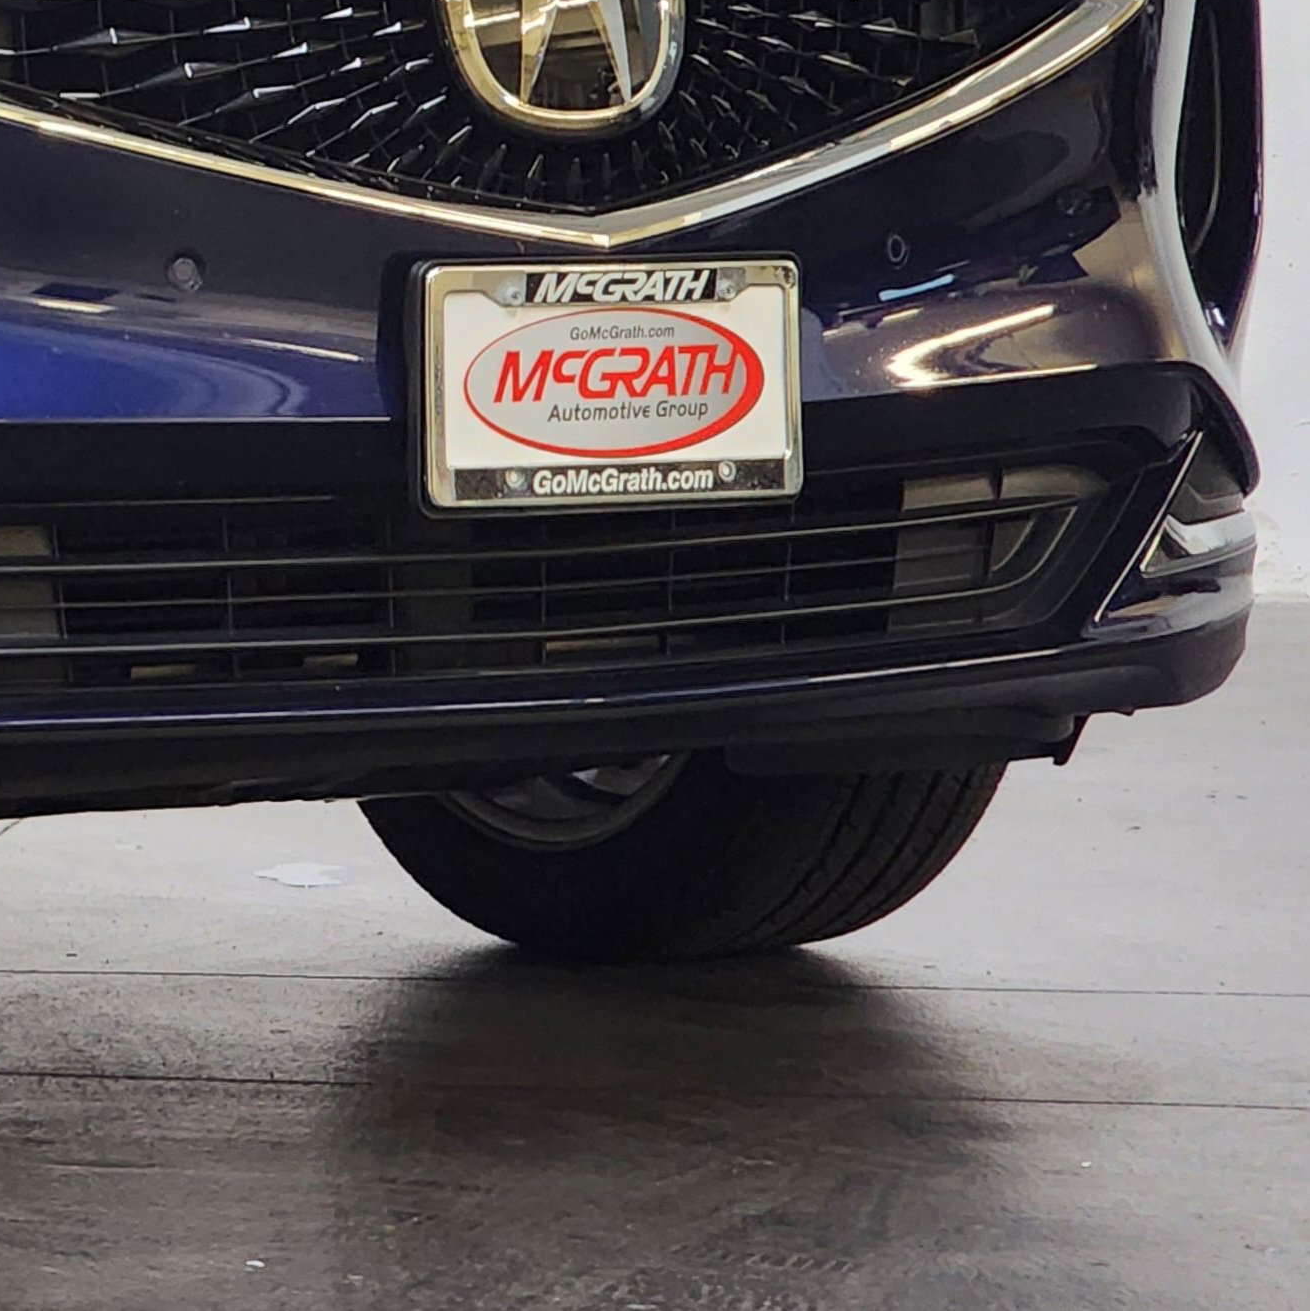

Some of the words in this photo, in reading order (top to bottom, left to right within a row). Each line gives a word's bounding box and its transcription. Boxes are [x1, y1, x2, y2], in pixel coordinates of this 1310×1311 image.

[570, 325, 675, 341] GoMcGrath.com
[548, 403, 651, 423] Automotive
[656, 399, 709, 421] Group
[534, 468, 714, 495] GoMcGrath.com
